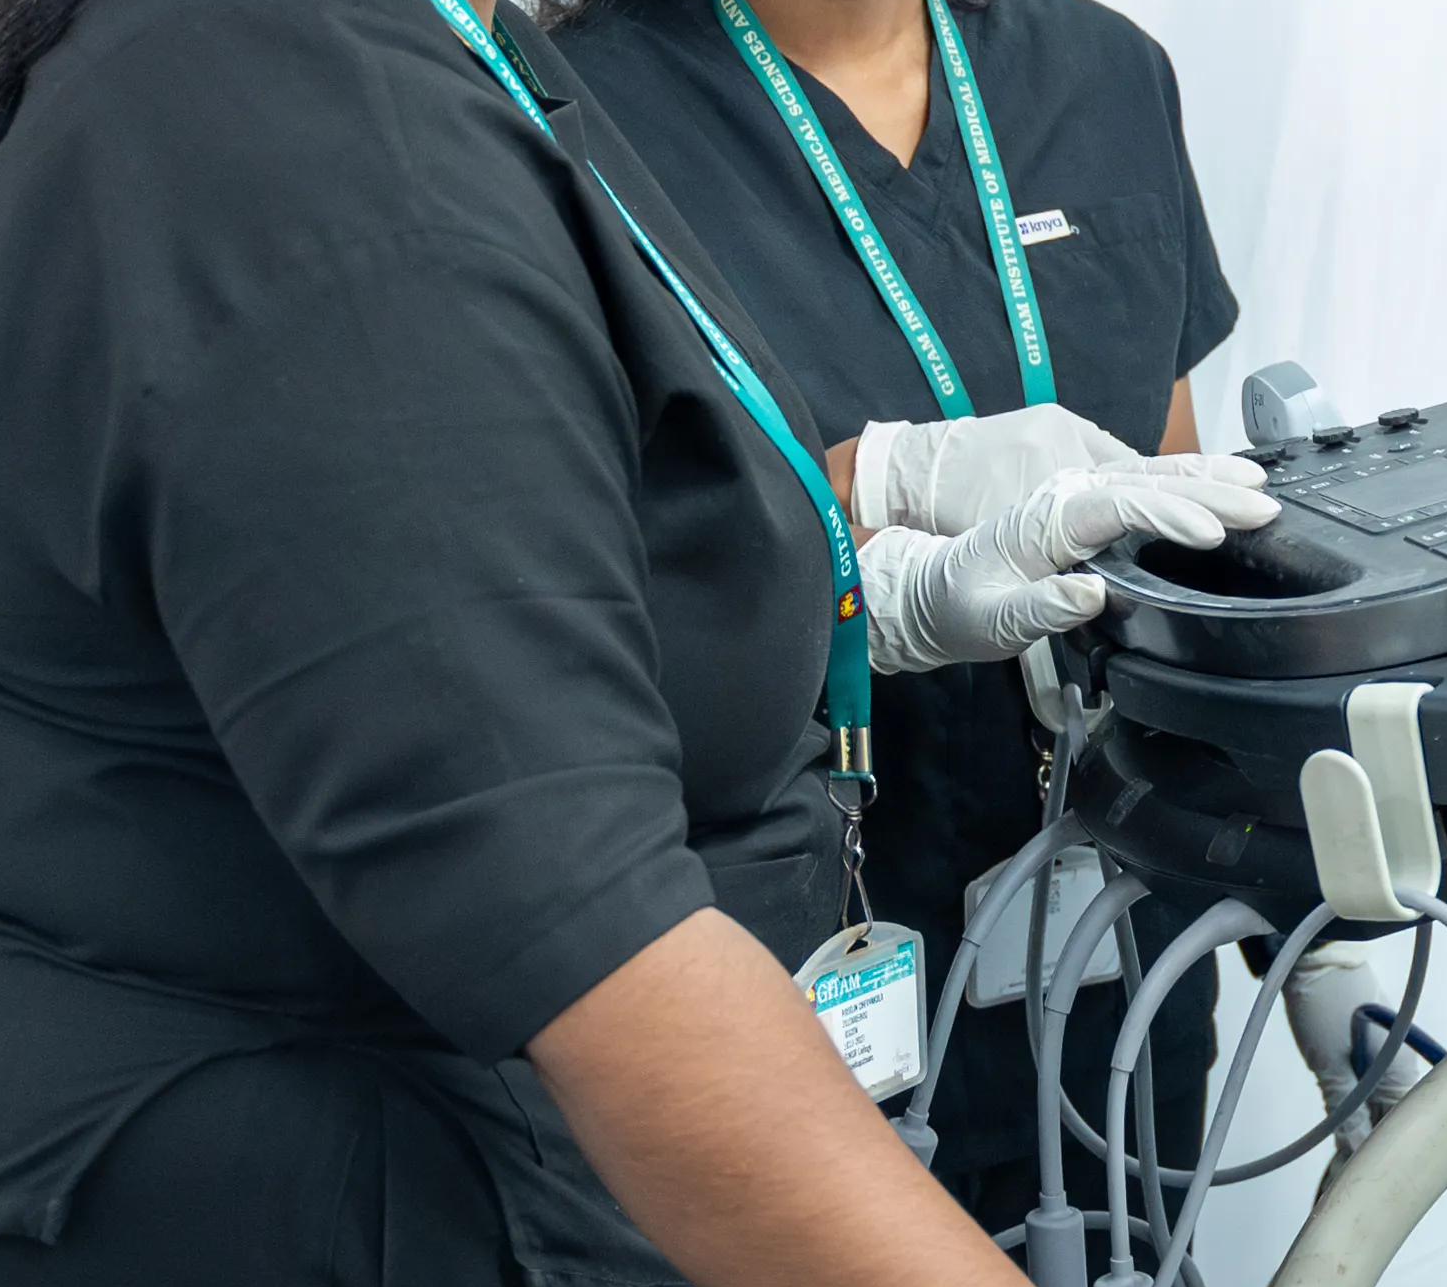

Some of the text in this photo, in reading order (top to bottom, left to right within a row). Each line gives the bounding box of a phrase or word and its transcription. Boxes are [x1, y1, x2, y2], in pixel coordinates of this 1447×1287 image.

[742, 30, 804, 117] SCIENCES
[958, 81, 993, 165] MEDICAL
[798, 117, 851, 203] MEDICAL
[982, 168, 1000, 195] OF
[844, 205, 865, 232] OF
[989, 198, 1027, 299] INSTITUTE
[1028, 216, 1064, 234] knya
[859, 234, 924, 334] INSTITUTE
[915, 331, 955, 396] GITAM
[1016, 302, 1043, 366] GITAM
[827, 503, 852, 577] GITAM
[816, 973, 861, 1004] GITAM
